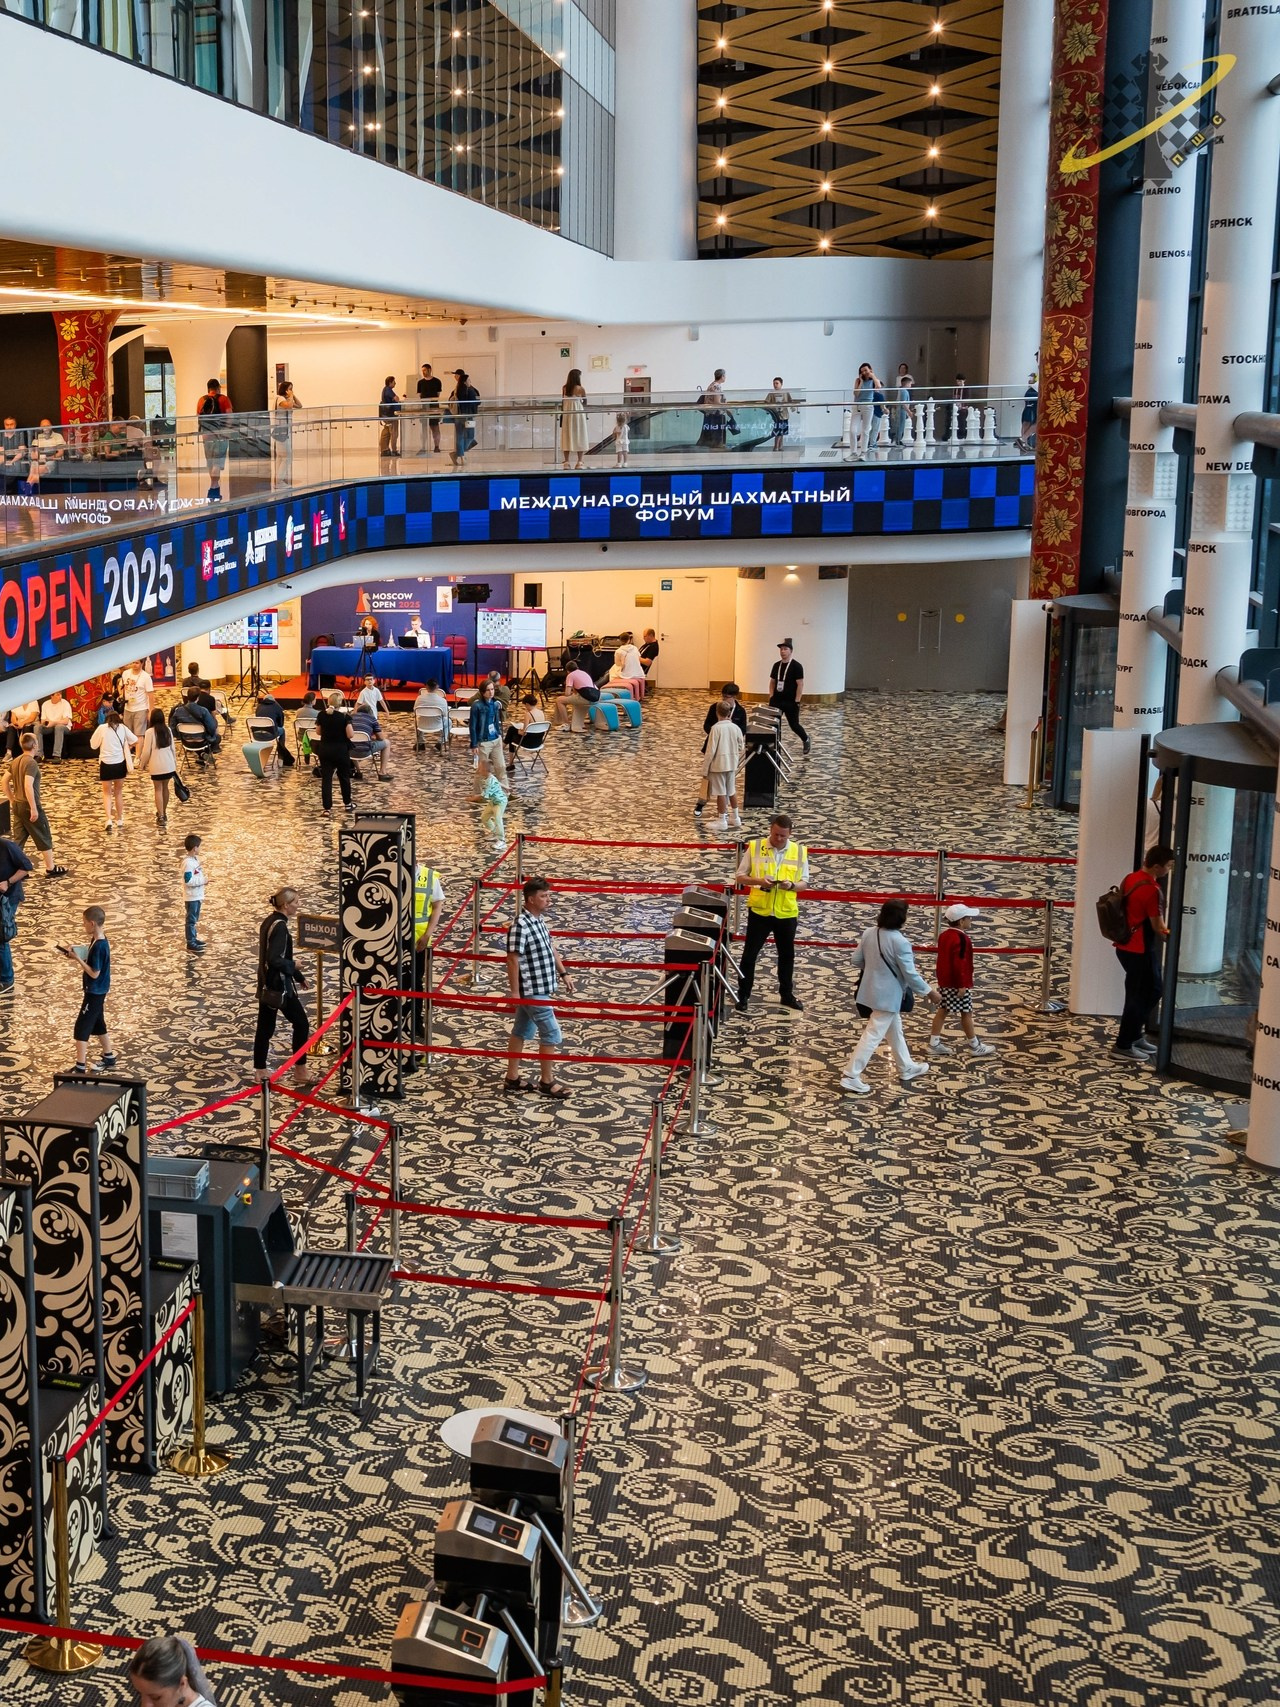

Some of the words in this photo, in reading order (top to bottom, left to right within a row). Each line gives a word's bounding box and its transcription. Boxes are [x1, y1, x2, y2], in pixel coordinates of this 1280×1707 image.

[1149, 250, 1185, 259] BUENOS
[1206, 462, 1232, 471] NEW
[501, 489, 703, 510] МЕЖДУНАРОДНЫЙ
[711, 486, 851, 505] ШАХМАТНЫЙ
[635, 507, 715, 522] ФОРУМ
[103, 541, 174, 624] 2025
[372, 592, 413, 600] MOSCOW
[372, 601, 396, 609] OPEN
[398, 601, 420, 609] 2025
[304, 922, 337, 937] ВЫХОД
